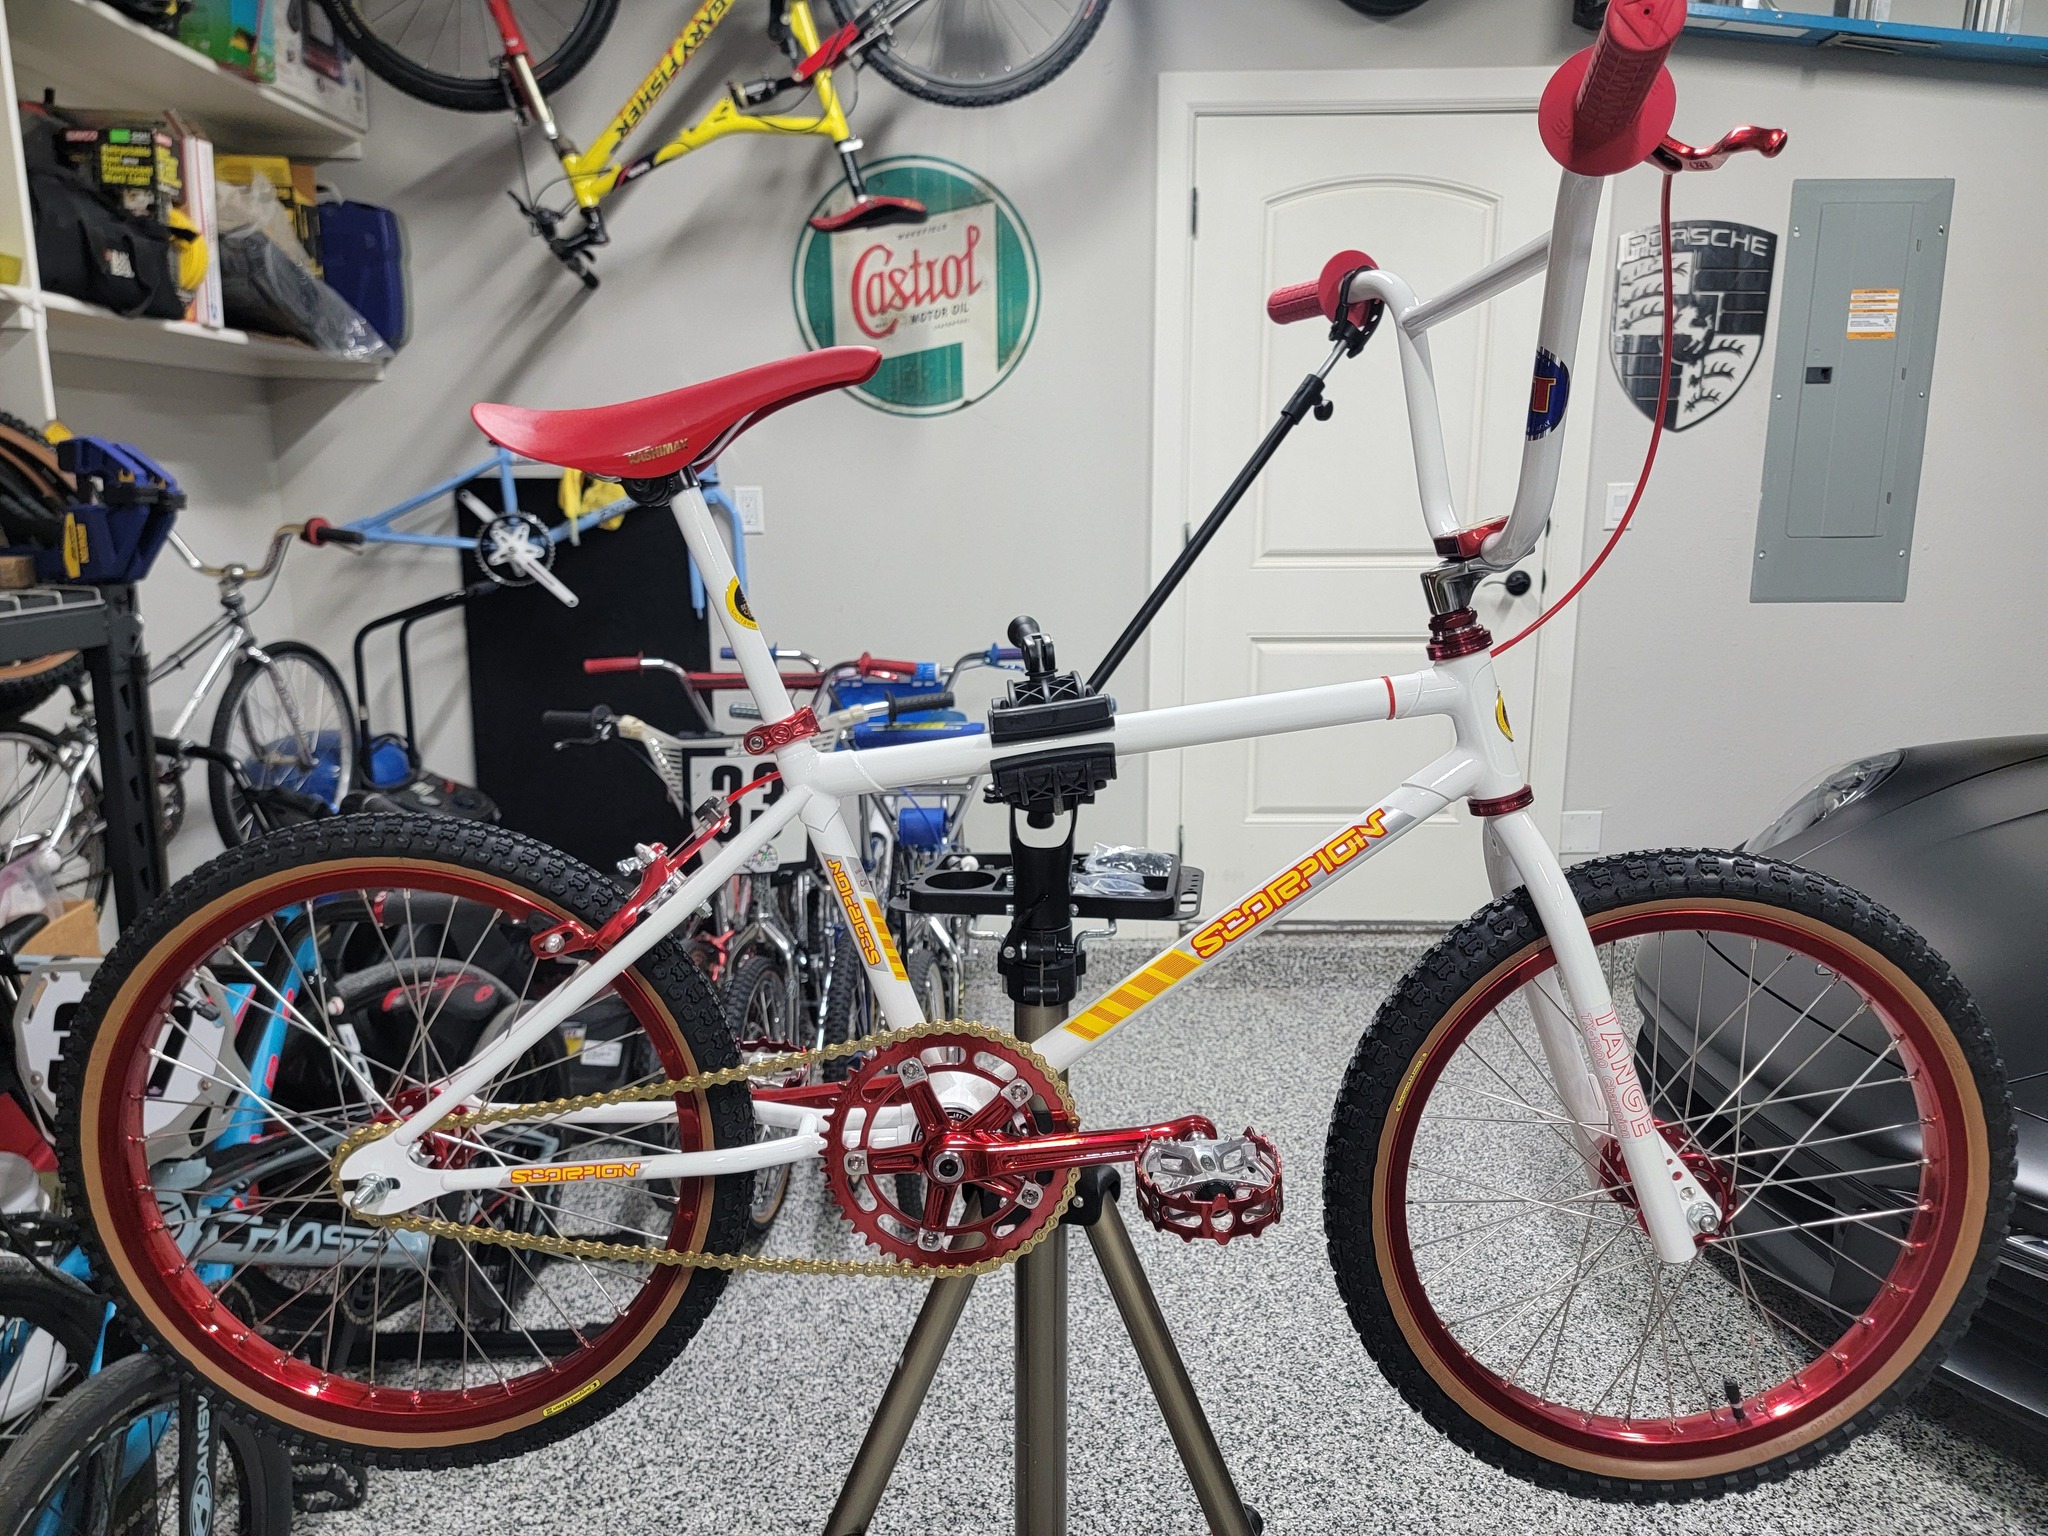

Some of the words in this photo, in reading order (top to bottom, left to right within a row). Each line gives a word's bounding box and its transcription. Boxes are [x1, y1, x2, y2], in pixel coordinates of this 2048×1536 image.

[616, 58, 681, 138] FISHER
[852, 224, 984, 339] Castrol
[1628, 227, 1769, 258] PORSCHE
[911, 308, 948, 325] MOTOR
[952, 303, 970, 316] OIL
[628, 437, 689, 465] KASHIMAX
[826, 859, 881, 966] SCORPION
[1191, 808, 1388, 959] SCORPION
[1581, 1013, 1608, 1068] TX-1200
[1602, 1075, 1631, 1138] Champion
[1595, 1003, 1655, 1138] TANGE
[511, 1162, 641, 1184] SCORPION
[205, 1213, 385, 1253] CHASE
